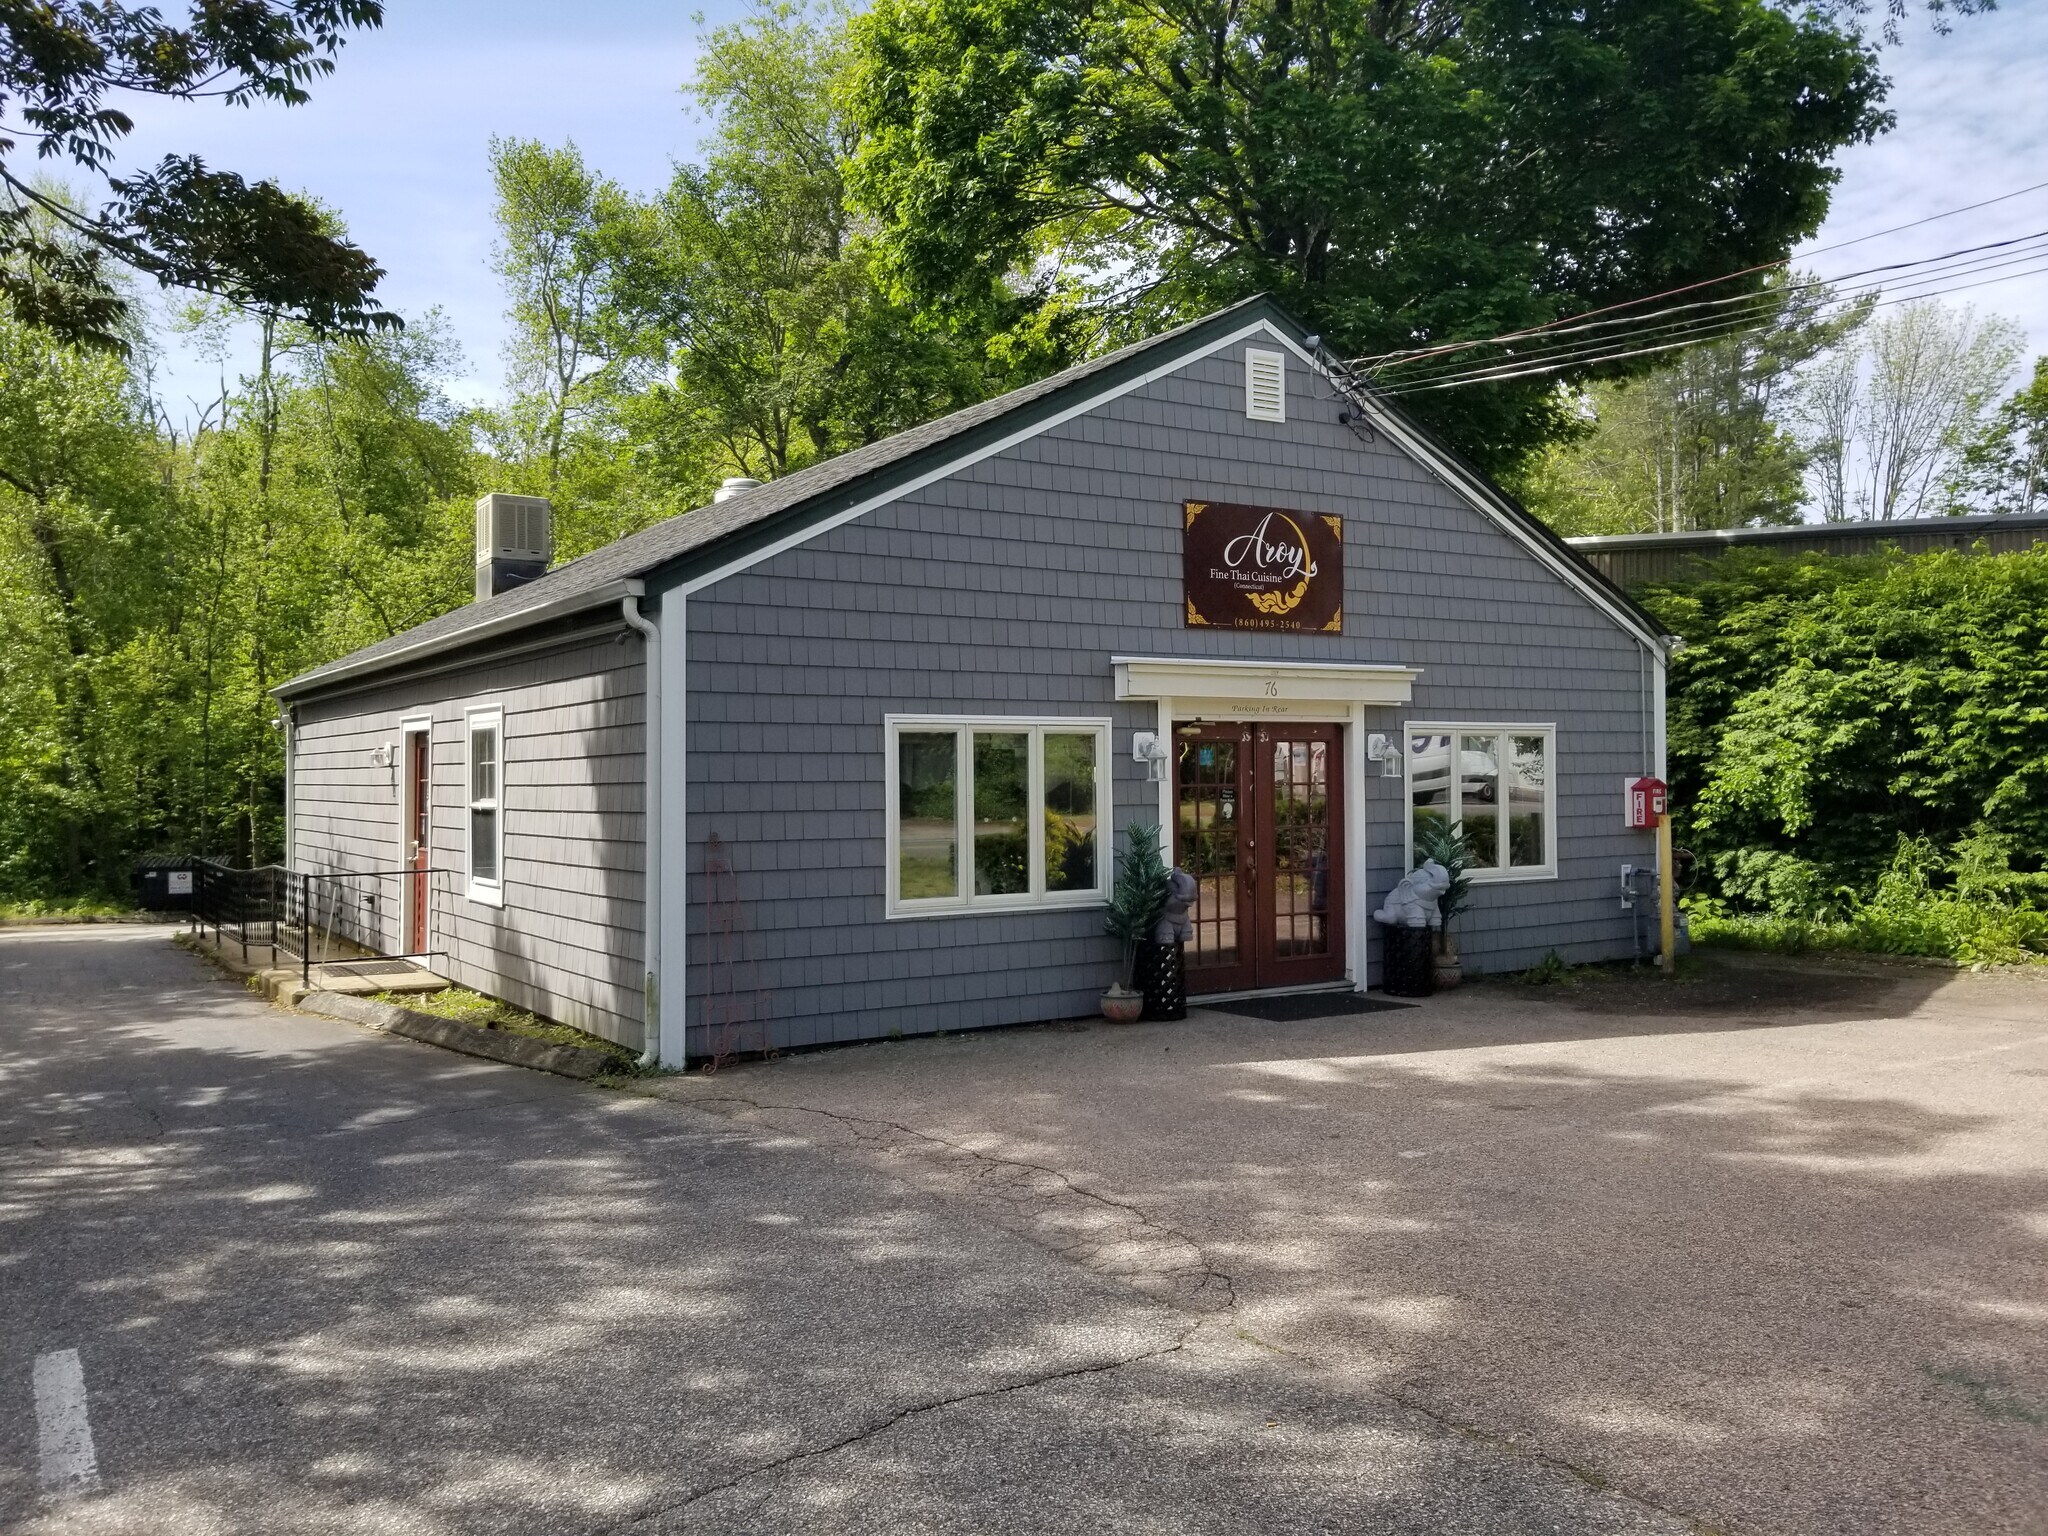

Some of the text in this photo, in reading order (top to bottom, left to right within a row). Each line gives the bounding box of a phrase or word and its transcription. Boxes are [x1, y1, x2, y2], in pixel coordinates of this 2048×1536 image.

[1224, 512, 1318, 579] Aroy
[1210, 568, 1282, 583] Fine Thai Cuisine
[1233, 582, 1265, 591] (Connecticut)
[1265, 681, 1278, 697] 76
[1231, 705, 1260, 714] Parking
[1272, 705, 1288, 714] Rear
